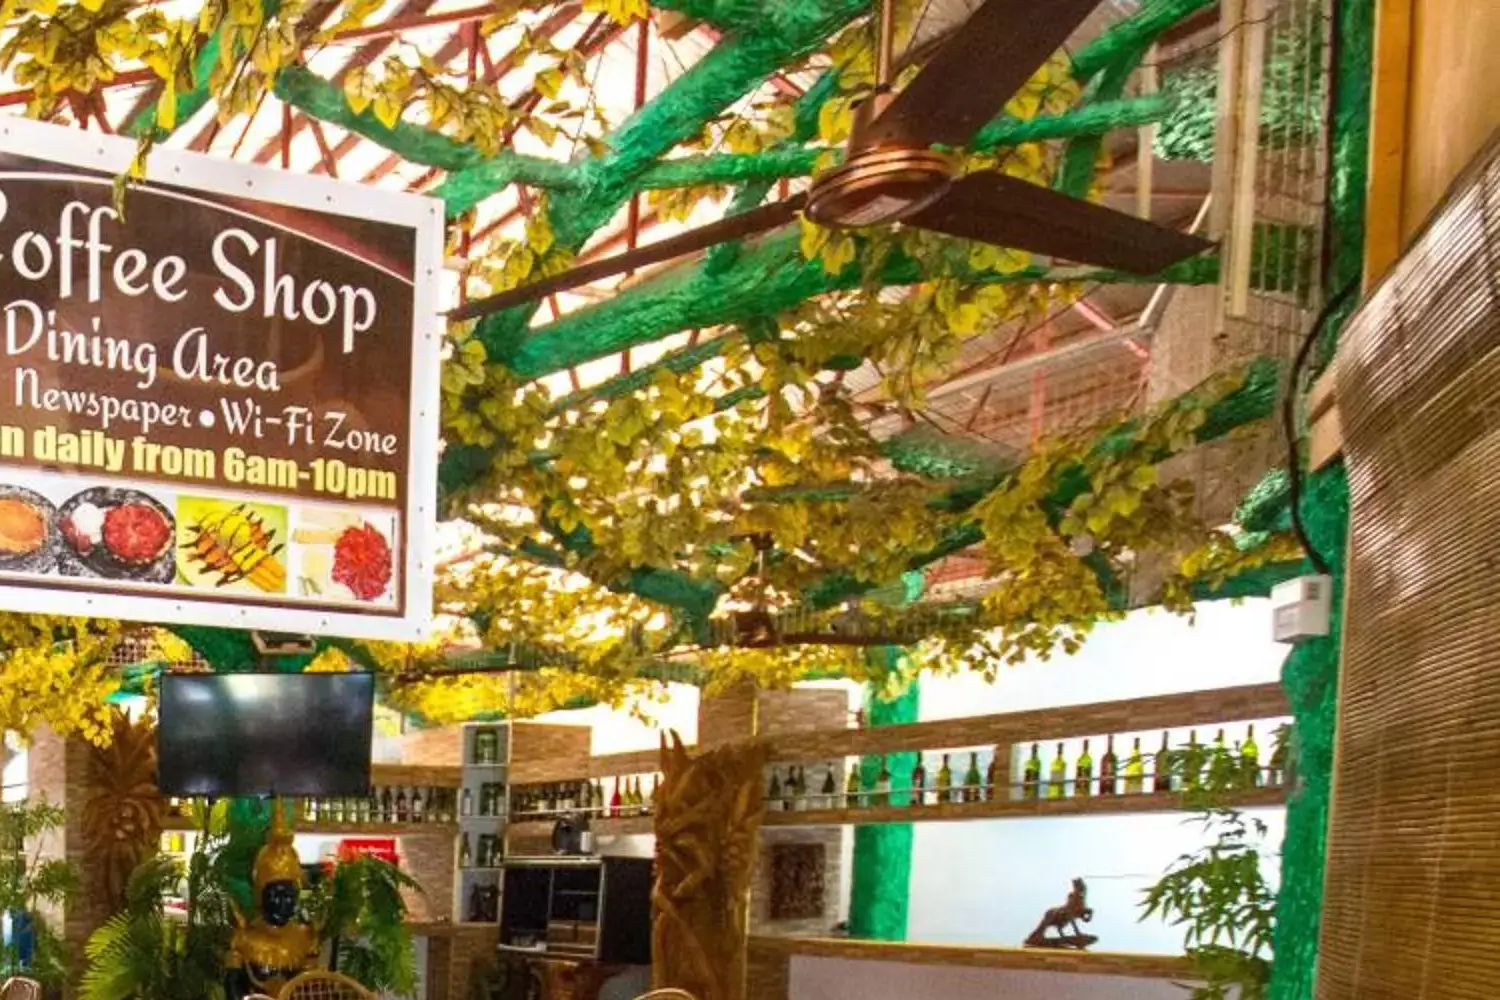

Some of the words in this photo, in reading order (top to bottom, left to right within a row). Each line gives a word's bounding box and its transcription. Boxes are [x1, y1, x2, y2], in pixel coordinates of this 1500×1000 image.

[212, 228, 377, 354] Shop
[3, 299, 157, 389] Dining
[172, 327, 280, 391] Area
[14, 366, 192, 433] Newspaper
[220, 397, 314, 446] Wi-Fi
[323, 410, 398, 456] Zone
[33, 422, 124, 474] daily
[132, 436, 215, 480] from
[223, 446, 397, 500] 6am-10pm
